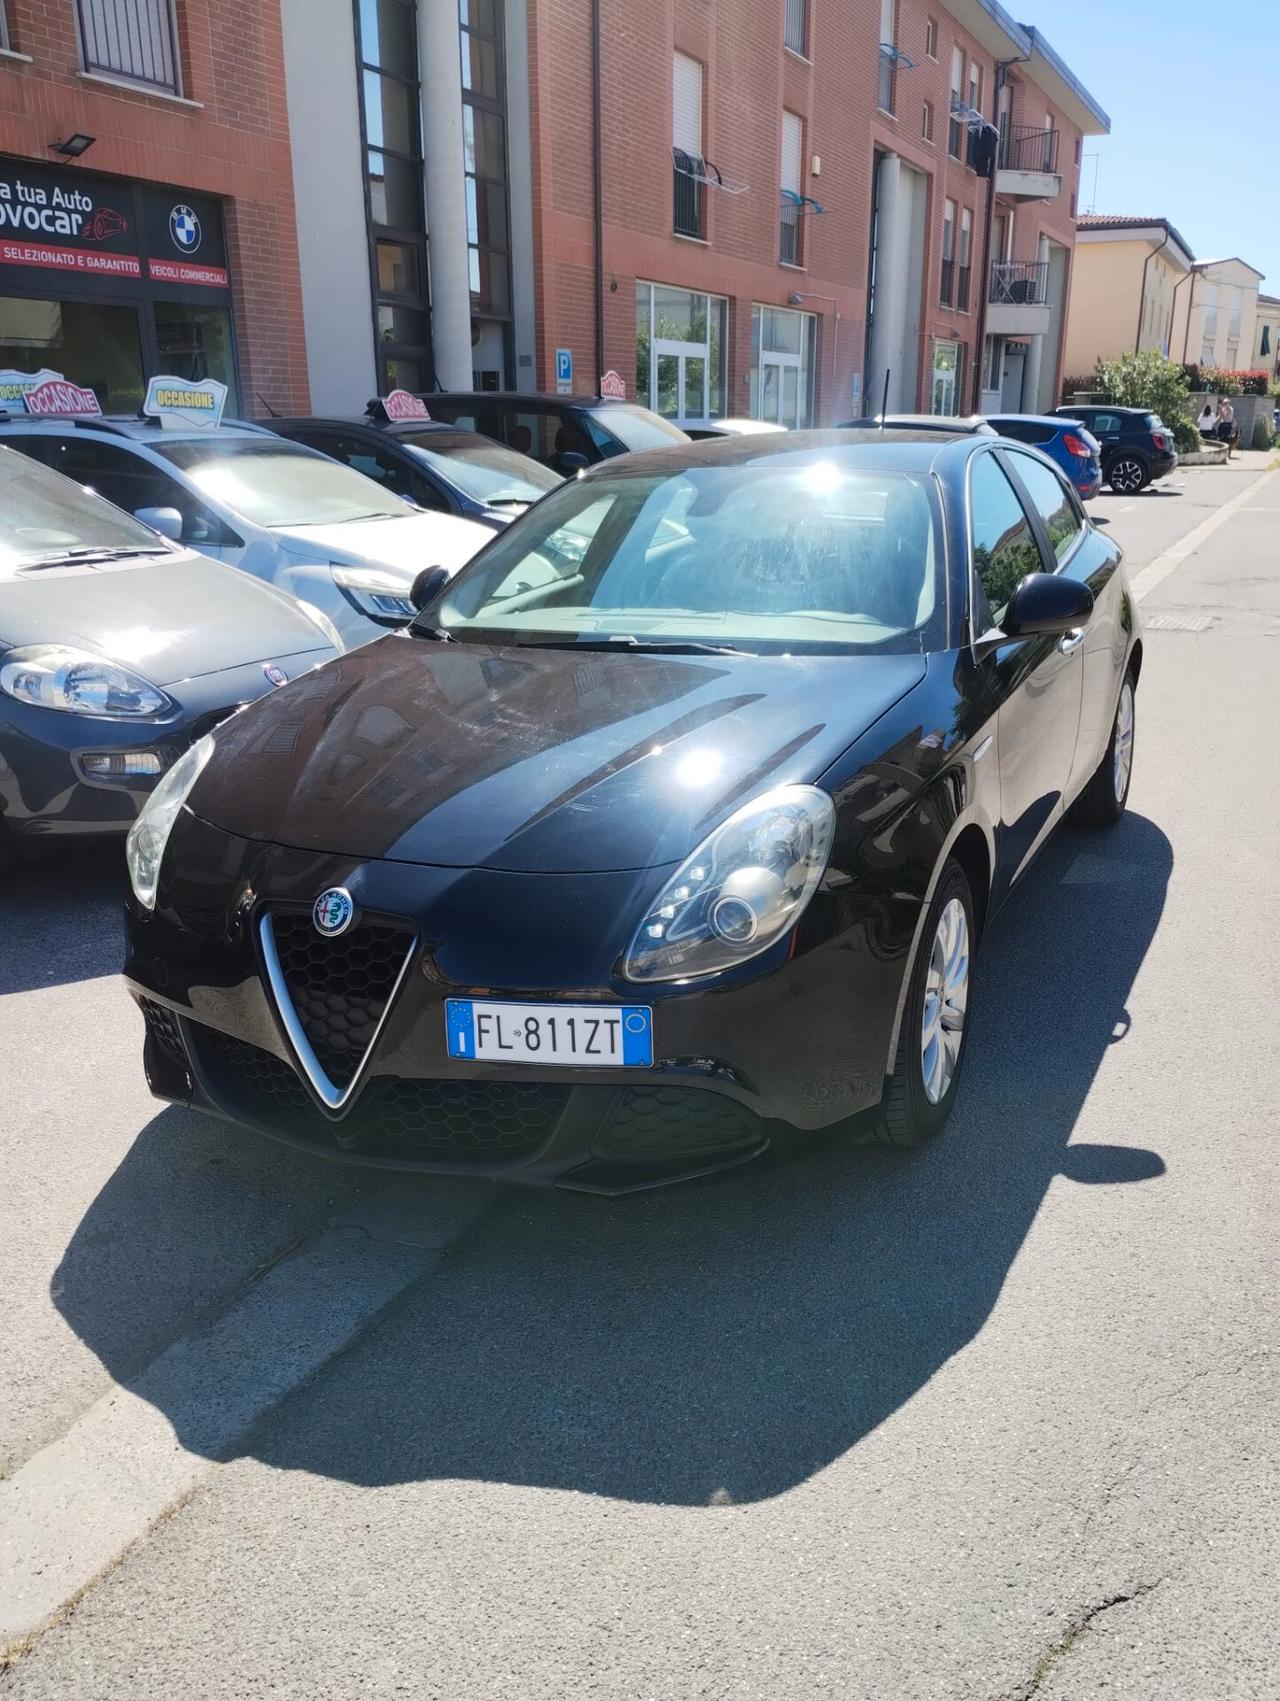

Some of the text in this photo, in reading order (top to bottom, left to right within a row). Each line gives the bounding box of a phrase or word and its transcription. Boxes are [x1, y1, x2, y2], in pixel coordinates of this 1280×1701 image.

[15, 180, 47, 205] tua
[52, 186, 92, 212] Auto
[172, 207, 199, 224] BMW
[4, 247, 140, 273] SELEZIONATO E GARANTITO
[150, 265, 228, 284] VEICOLI COMMERCIALI
[560, 355, 568, 377] P
[29, 383, 98, 413] OCCASIONE
[157, 389, 214, 409] OCCASIONE
